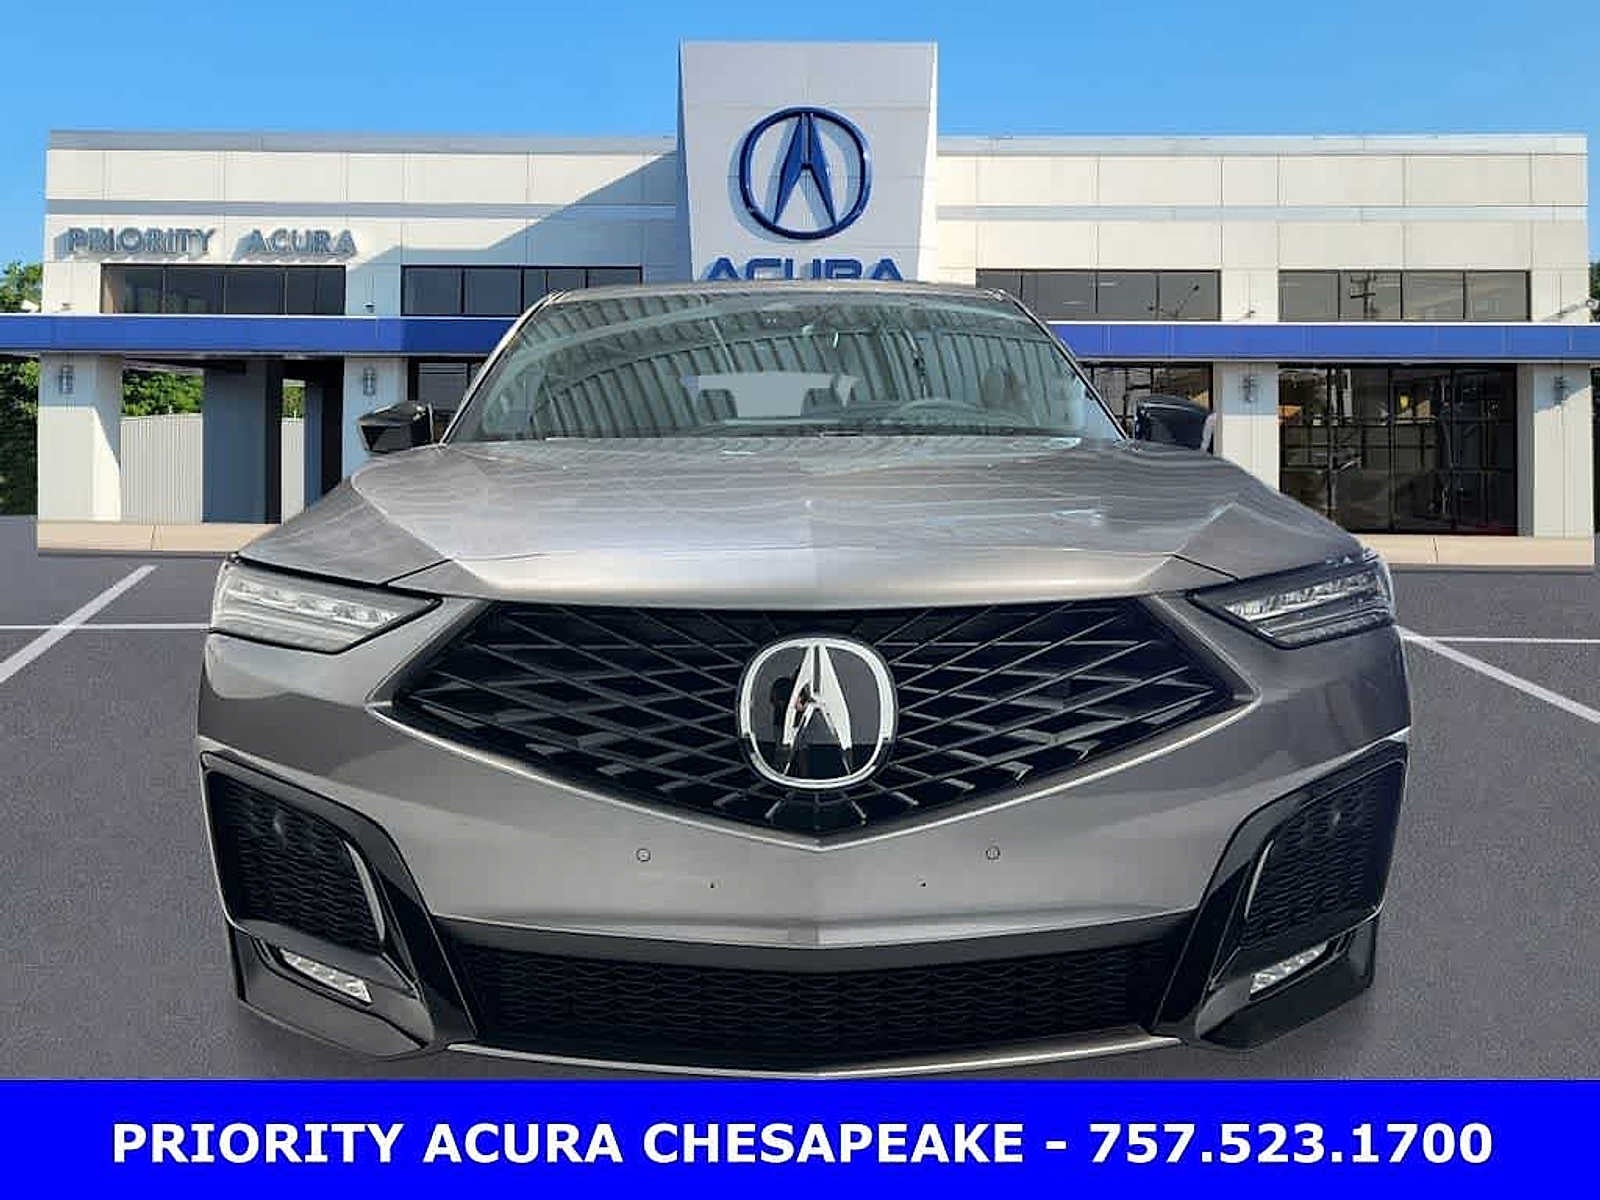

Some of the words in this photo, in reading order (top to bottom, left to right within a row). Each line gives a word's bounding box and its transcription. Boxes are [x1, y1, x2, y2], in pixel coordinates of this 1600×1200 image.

[67, 227, 215, 253] PRIORITY
[247, 229, 357, 257] ACURA
[706, 257, 904, 281] ACURA
